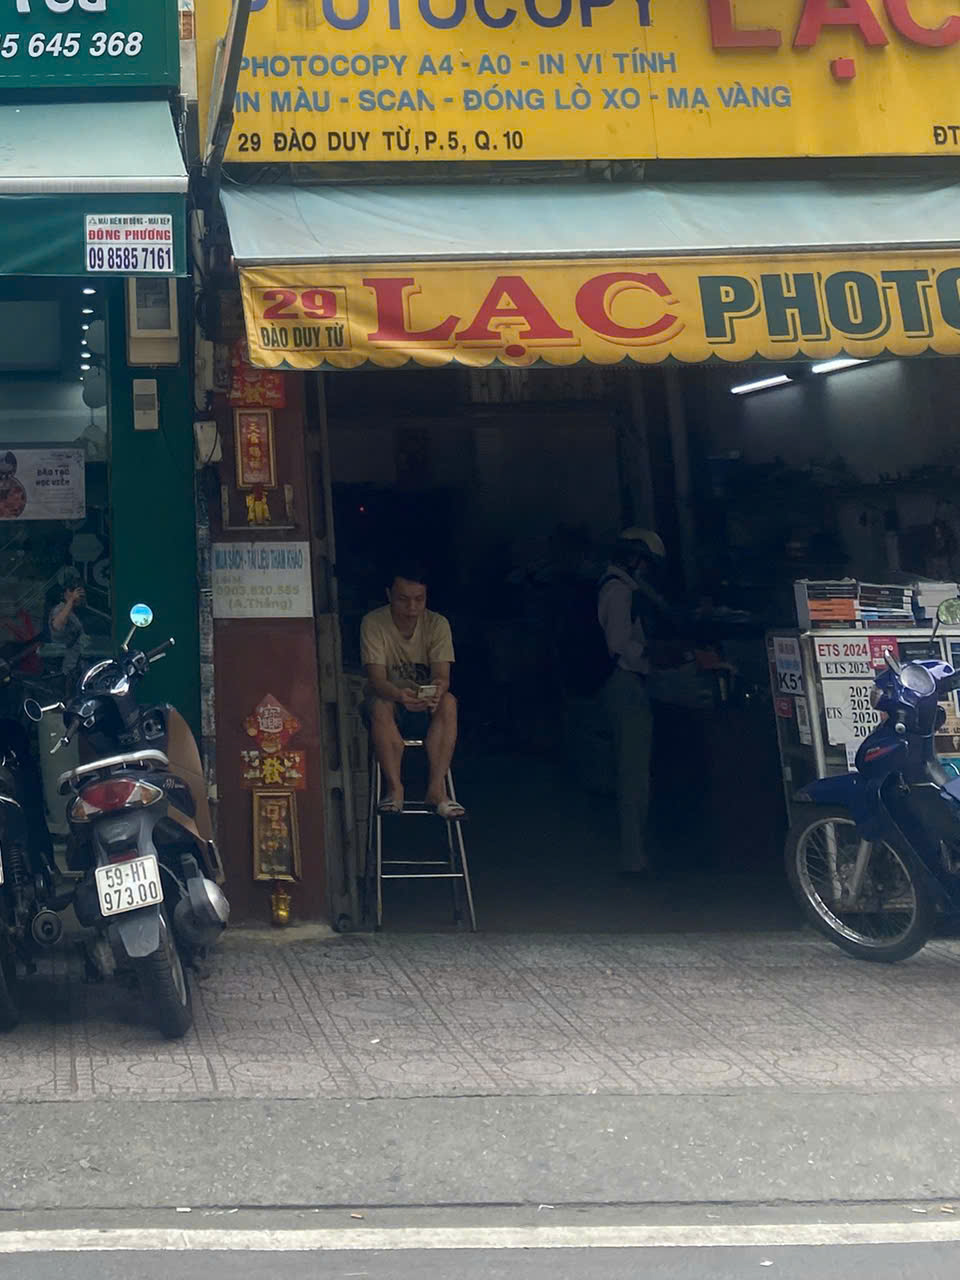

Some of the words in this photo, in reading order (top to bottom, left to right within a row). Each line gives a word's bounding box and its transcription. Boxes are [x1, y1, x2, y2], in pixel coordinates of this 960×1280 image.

[27, 33, 80, 59] 645
[88, 31, 143, 58] 368
[418, 53, 454, 76] A4
[539, 52, 564, 74] IN
[576, 52, 602, 74] VI
[612, 47, 677, 73] TÍNH
[271, 86, 331, 113] MÀU
[358, 88, 436, 112] SCAN
[463, 84, 545, 111] ĐÓNG
[554, 84, 592, 111] LÒ
[602, 87, 641, 110] XO
[667, 86, 710, 113] MẠ
[717, 81, 792, 108] VÀNG
[238, 133, 262, 152] 29
[274, 127, 317, 152] ĐÀO
[327, 131, 370, 152] DUY
[125, 227, 171, 240] PHƯƠNG
[89, 247, 104, 269] 09
[108, 247, 138, 269] 8585
[142, 247, 171, 269] 7161
[262, 288, 338, 320] 29
[363, 271, 684, 358] LẠC
[261, 322, 289, 349] ĐÀO
[292, 326, 322, 349] DUY
[325, 322, 347, 347] TỪ
[818, 644, 840, 656] ETS
[843, 643, 868, 656] 2024
[826, 663, 847, 674] ETS
[849, 662, 870, 673] 2023
[849, 686, 872, 698] 202
[826, 707, 842, 719] ETS
[852, 712, 878, 723] 2020
[854, 726, 873, 737] 201
[105, 861, 147, 888] 59-H1
[104, 881, 158, 911] 973.00
